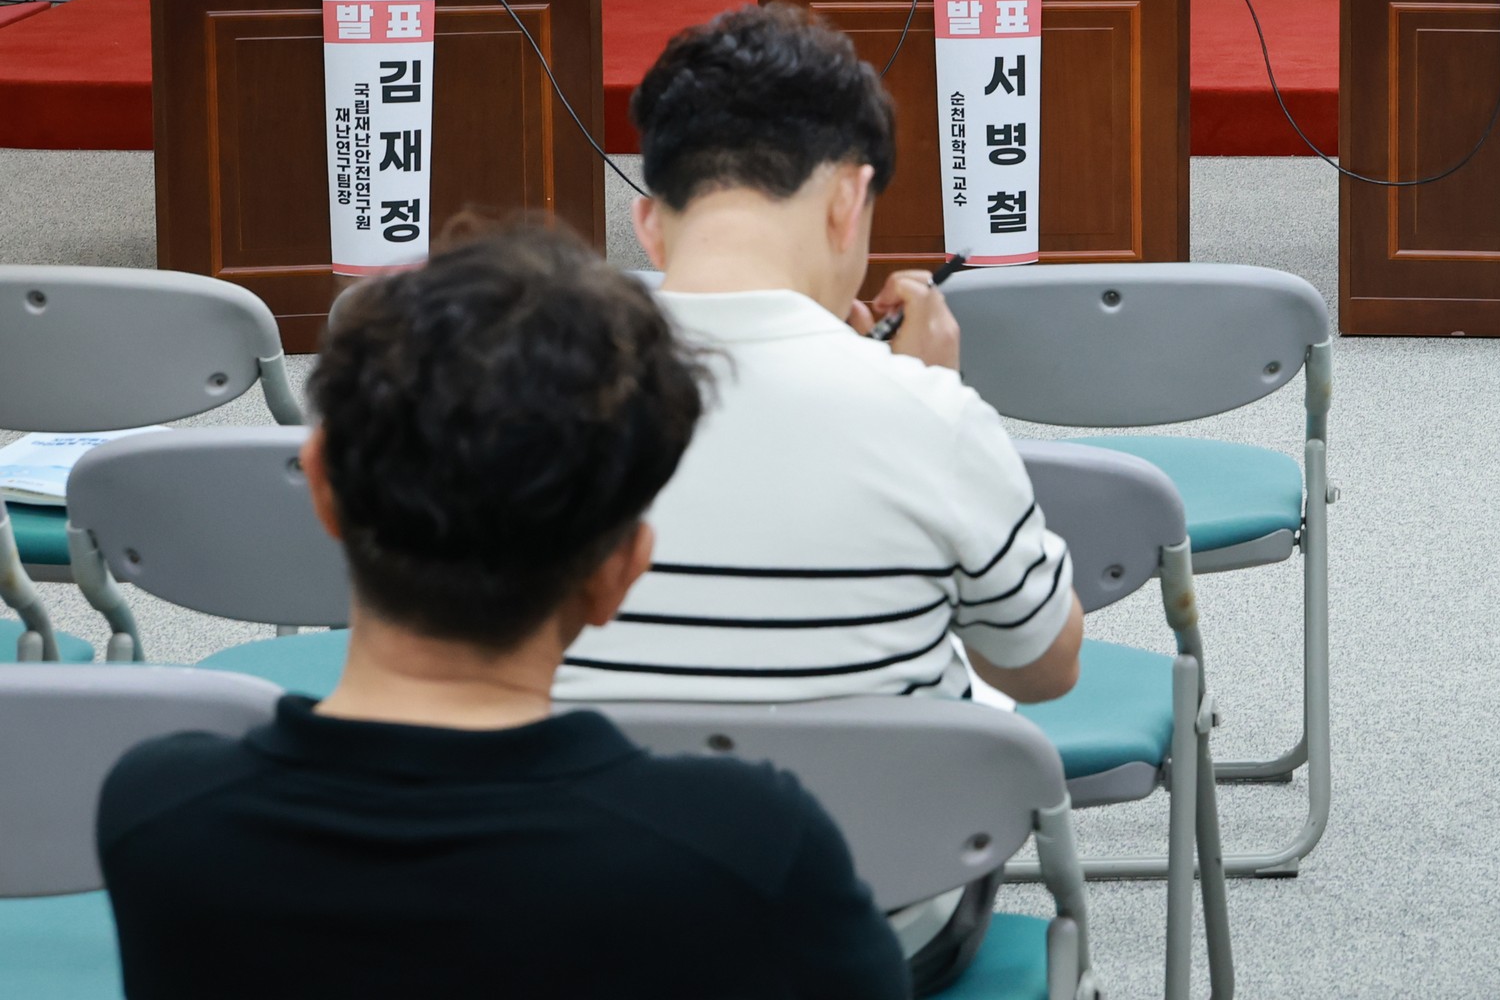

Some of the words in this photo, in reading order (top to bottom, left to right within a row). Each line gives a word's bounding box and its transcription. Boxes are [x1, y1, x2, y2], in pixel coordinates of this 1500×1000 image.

[337, 4, 422, 39] 발표
[947, 0, 1029, 34] 발표
[336, 108, 351, 204] 재난연구팀장
[354, 83, 371, 230] 국립재난안전연구원
[380, 60, 421, 242] 김재정
[951, 91, 966, 170] 순천대학교
[985, 55, 1027, 233] 서병철
[953, 177, 967, 207] 교수
